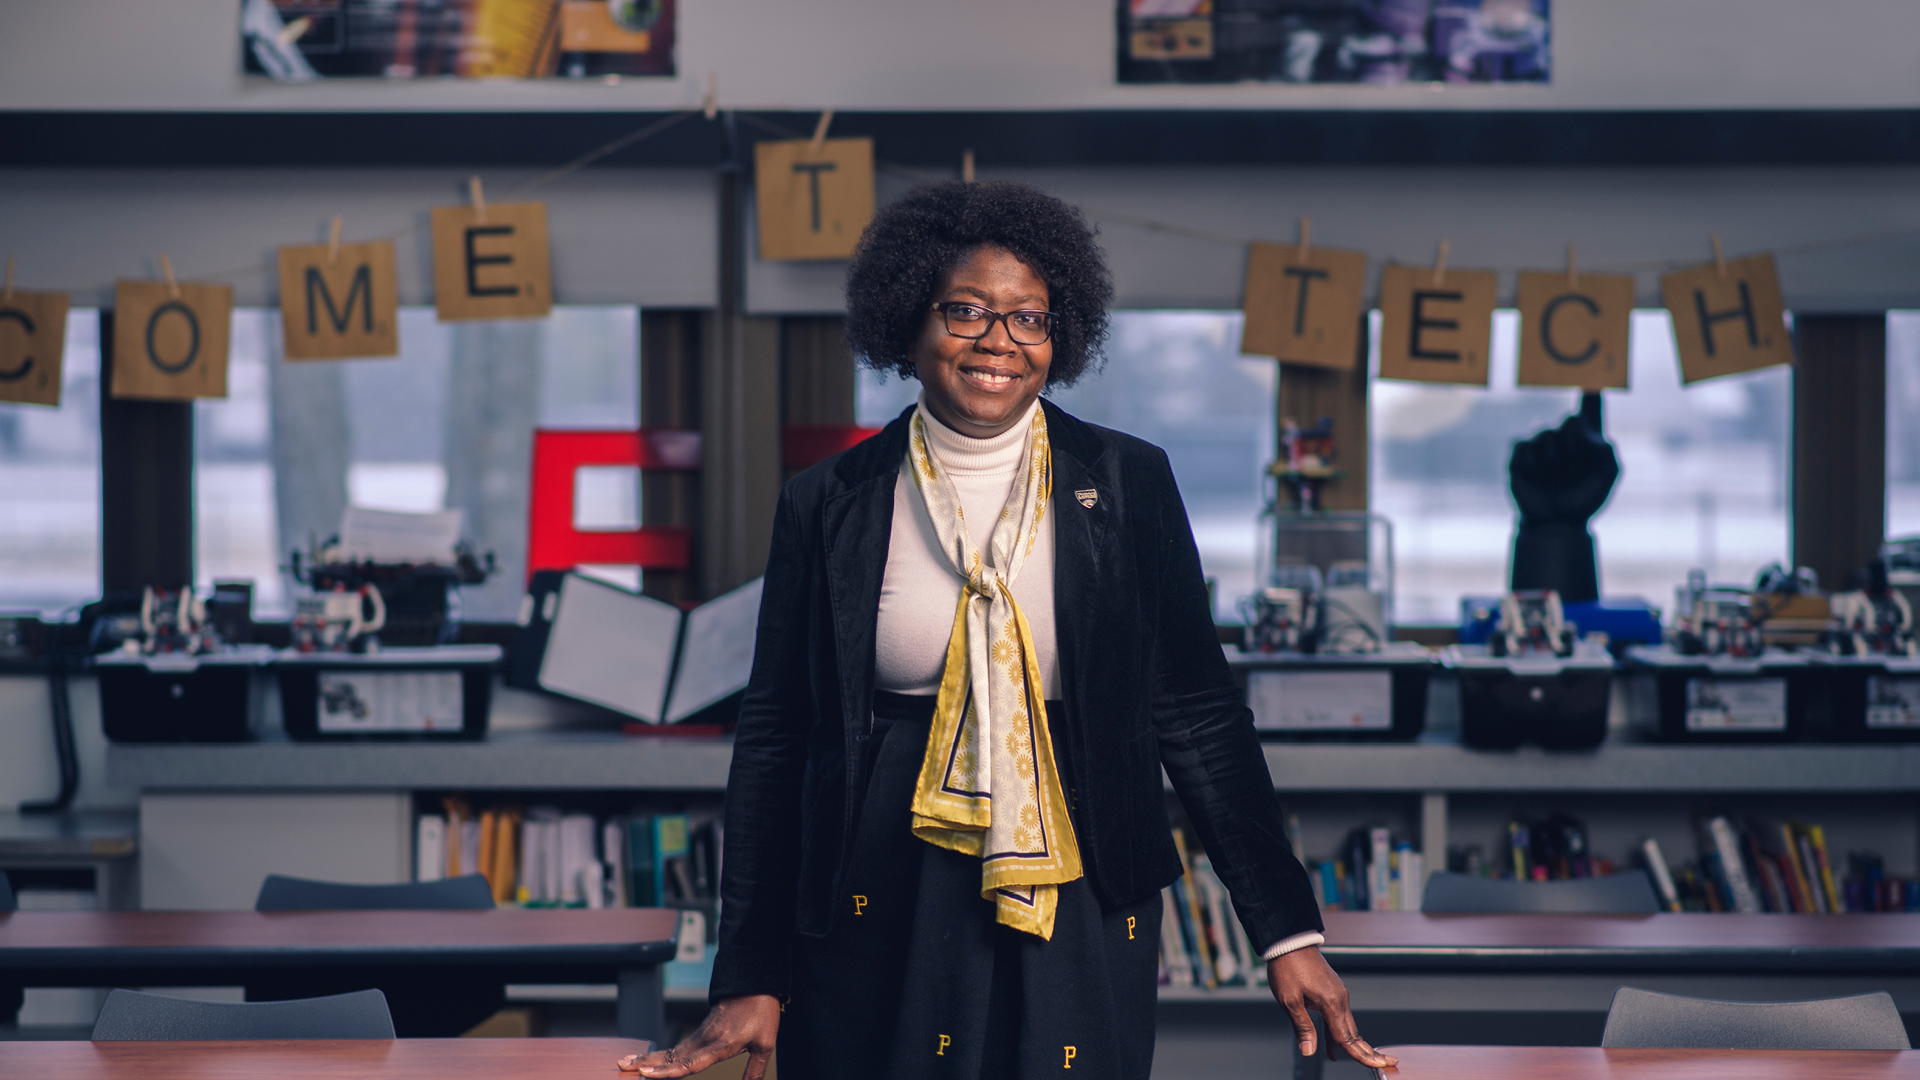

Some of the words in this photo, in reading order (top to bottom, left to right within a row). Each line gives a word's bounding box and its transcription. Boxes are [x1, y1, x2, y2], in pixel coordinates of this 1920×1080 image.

[1283, 265, 1759, 366] TECH
[852, 895, 868, 916] P
[1126, 915, 1137, 940] P
[936, 1033, 951, 1056] P
[1063, 1045, 1077, 1069] P
